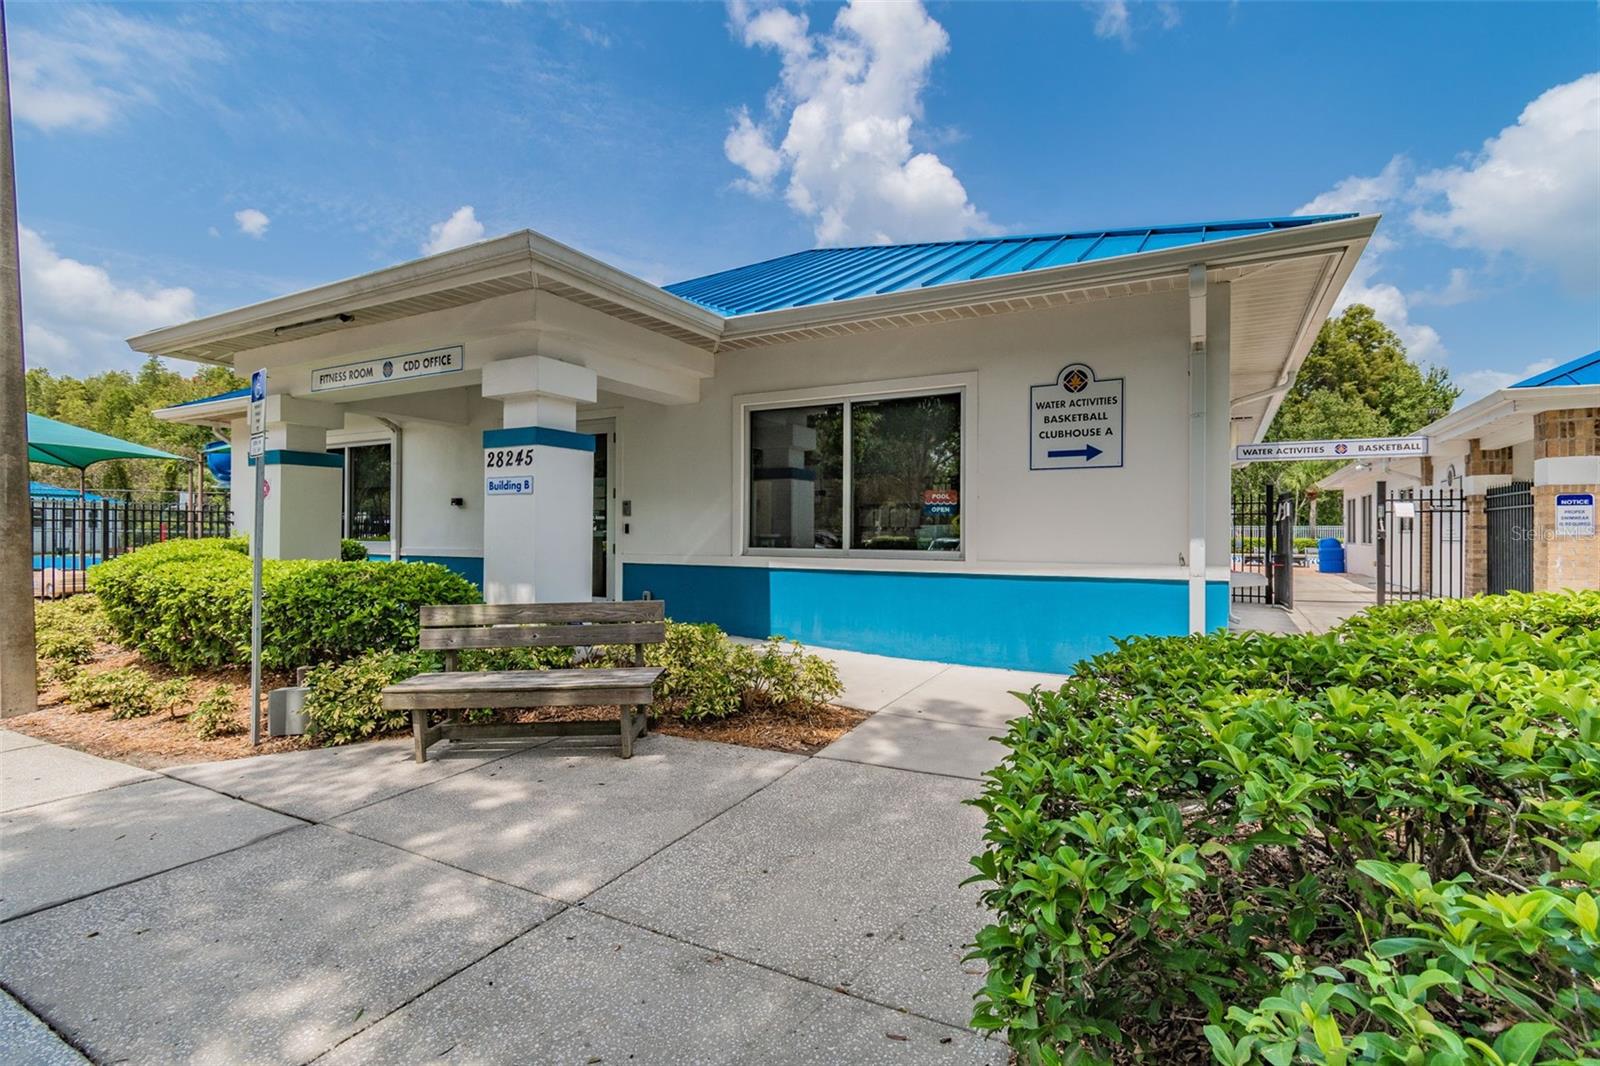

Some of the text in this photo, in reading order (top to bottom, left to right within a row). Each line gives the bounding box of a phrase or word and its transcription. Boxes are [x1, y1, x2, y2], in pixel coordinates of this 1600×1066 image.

[319, 354, 452, 385] FITNESS ROOM CDD OFFICE
[1035, 396, 1118, 410] WATER ACTIVITIES
[1043, 412, 1108, 424] BASKETBALL
[1038, 427, 1113, 440] CLUBHOUSE A
[1242, 443, 1421, 456] WATER ACTIVITIES BASKETBALL
[487, 449, 534, 468] 28245
[489, 480, 530, 492] Building B
